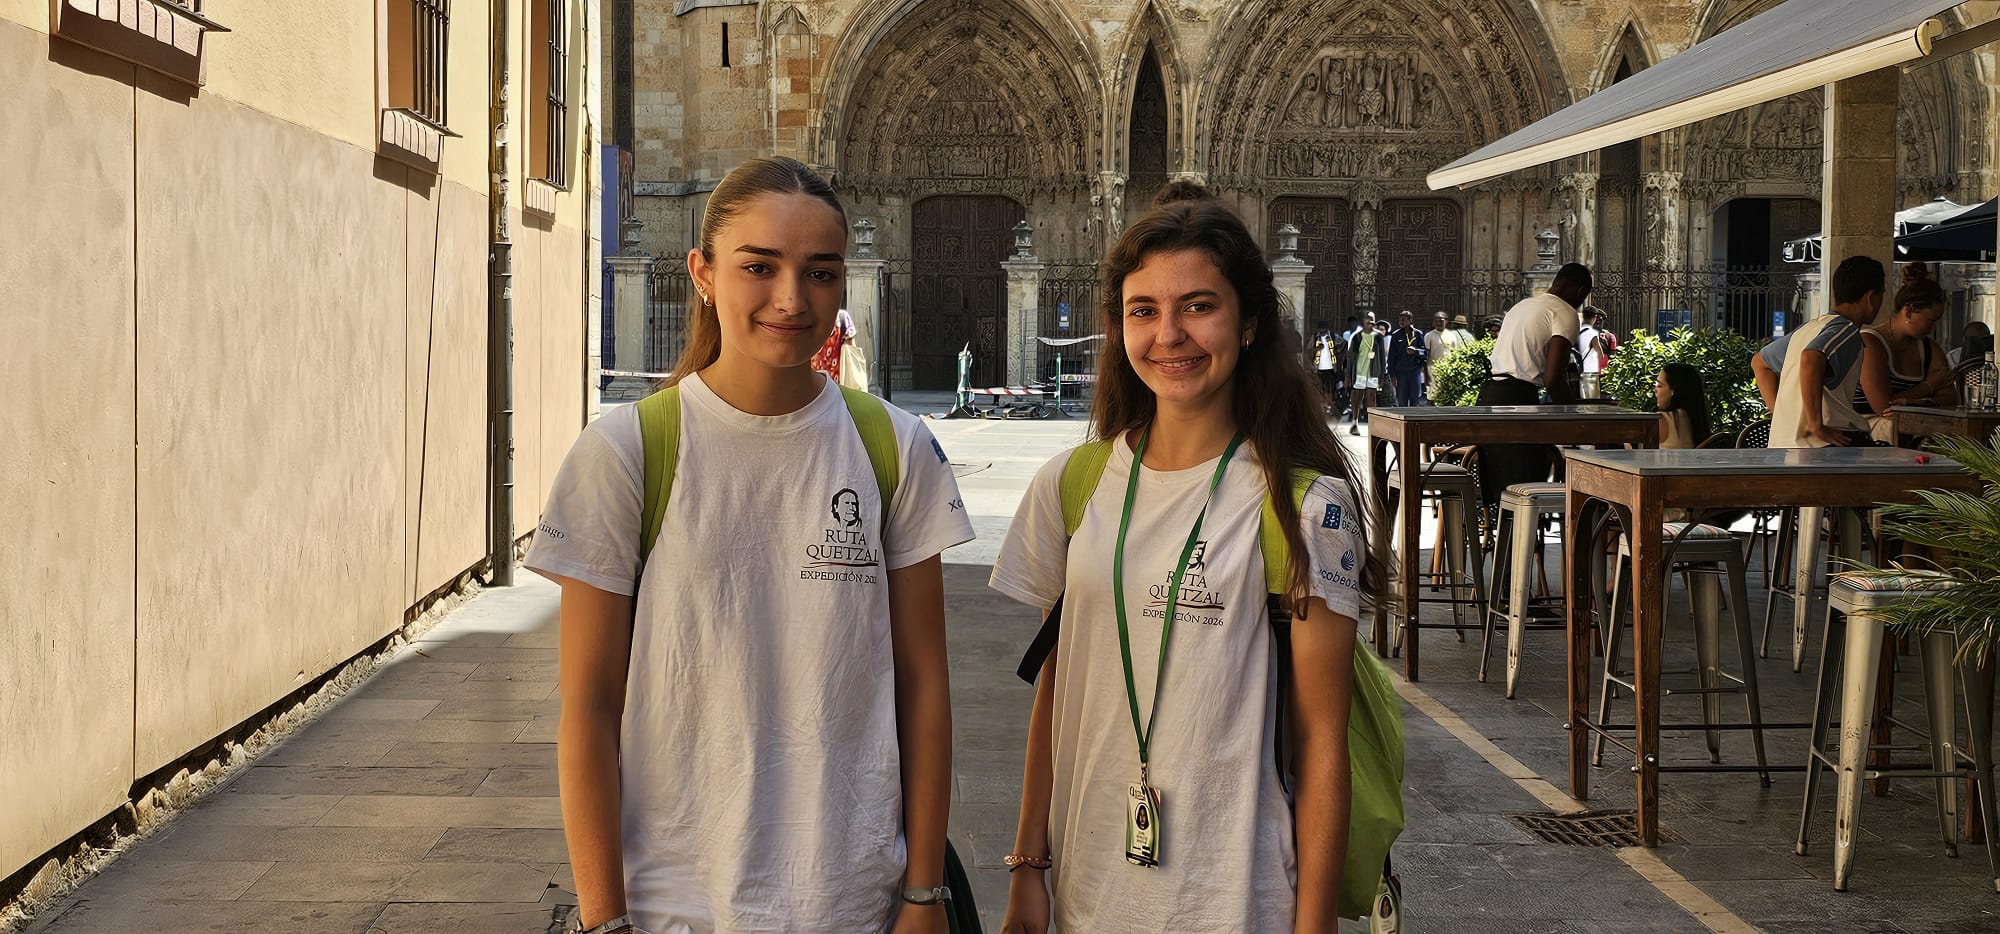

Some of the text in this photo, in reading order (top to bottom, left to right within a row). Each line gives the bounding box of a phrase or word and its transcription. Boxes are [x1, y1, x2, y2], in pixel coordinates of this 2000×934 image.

[825, 529, 867, 545] RUTA
[800, 570, 863, 583] EXPEDICIÓN
[1149, 585, 1223, 605] QUTZAL
[1142, 608, 1224, 627] EXPECIÓN 2026
